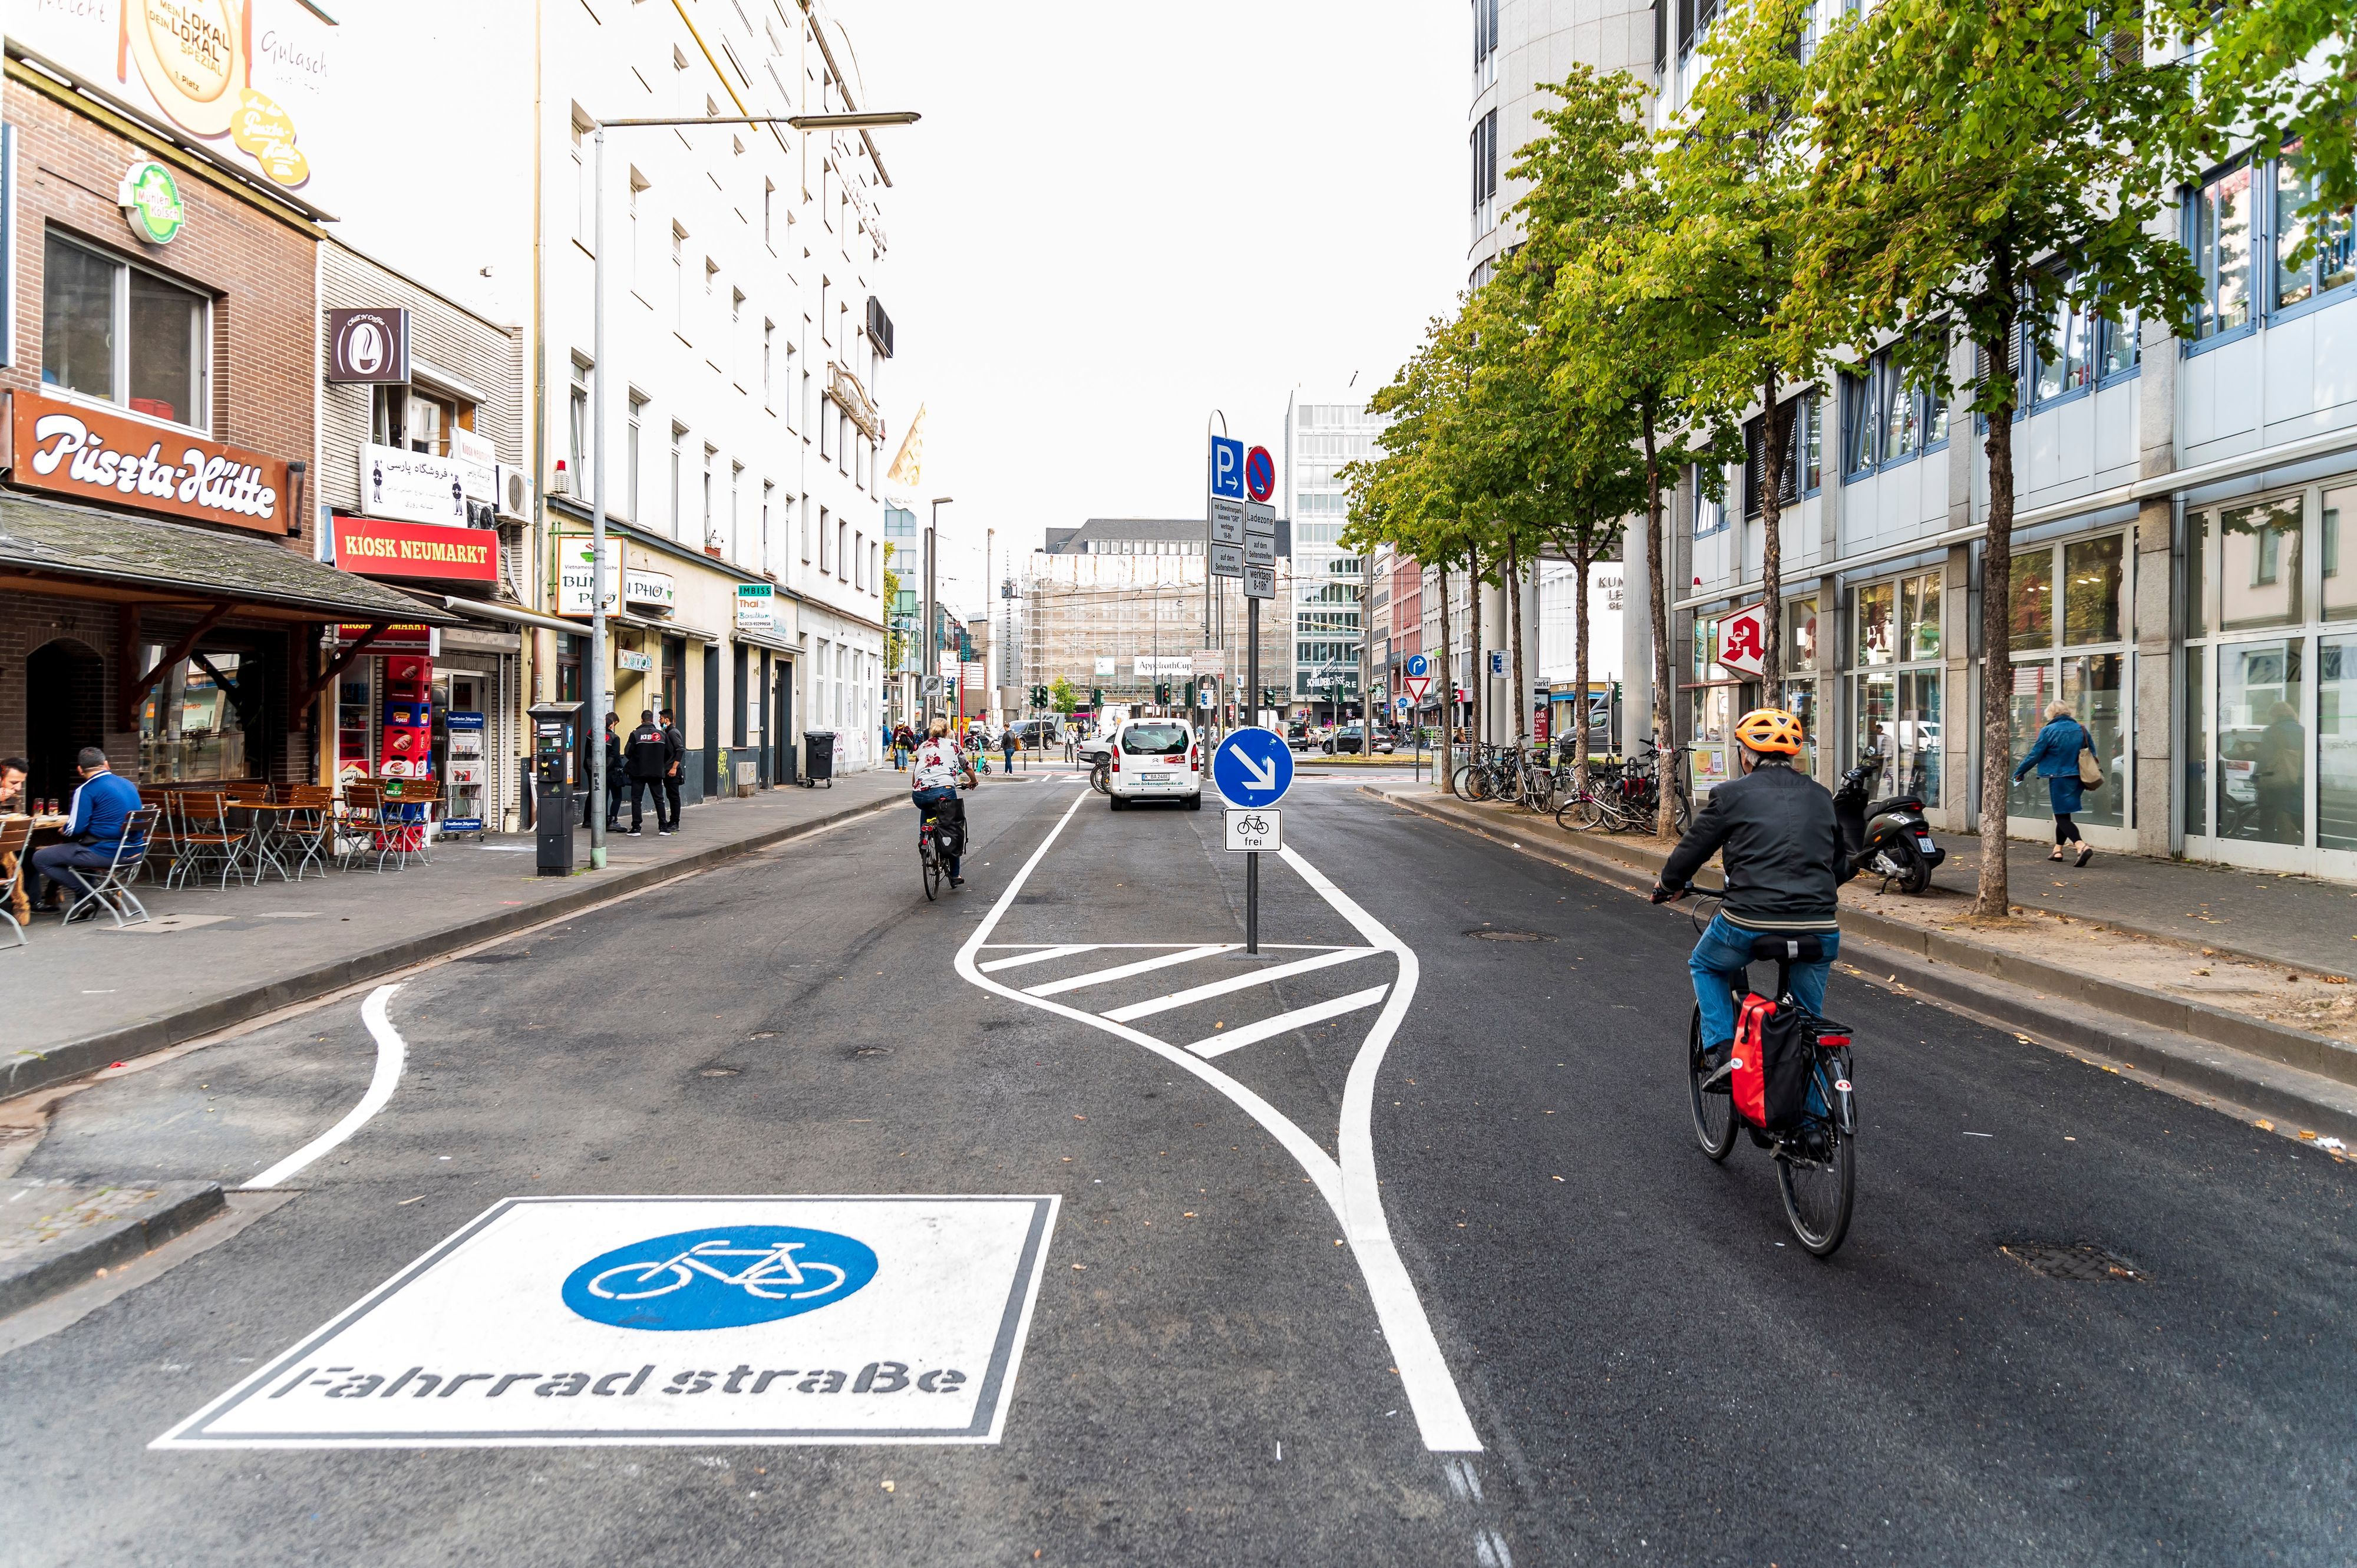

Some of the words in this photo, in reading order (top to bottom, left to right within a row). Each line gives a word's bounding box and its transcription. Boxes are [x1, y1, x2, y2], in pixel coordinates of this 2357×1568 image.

[160, 0, 181, 18] MEIN
[183, 6, 230, 51] LOKAL
[150, 11, 170, 29] DEIN
[172, 18, 220, 62] LOKAL
[181, 42, 223, 77] SPEZIAL
[261, 31, 328, 77] Gulasch
[182, 75, 200, 92] Platz
[138, 189, 170, 205] Mühlen
[151, 206, 179, 219] Kölsch
[387, 461, 411, 476] پارسی
[414, 463, 448, 479] فروشگاه
[1217, 444, 1234, 488] P
[1220, 504, 1243, 514] Bewohnerpark-
[1247, 511, 1273, 526] Ladezone
[1220, 523, 1234, 532] werktags
[345, 535, 398, 559] KIOSK
[400, 540, 488, 565] NEUMARKT
[1249, 550, 1272, 560] Seitenstreifen
[1215, 563, 1240, 573] Seitenstreifen
[1250, 569, 1272, 583] werktags
[1253, 580, 1267, 592] 8-18h
[739, 599, 758, 608] Thai
[568, 728, 573, 742] P
[1245, 837, 1262, 846] frei
